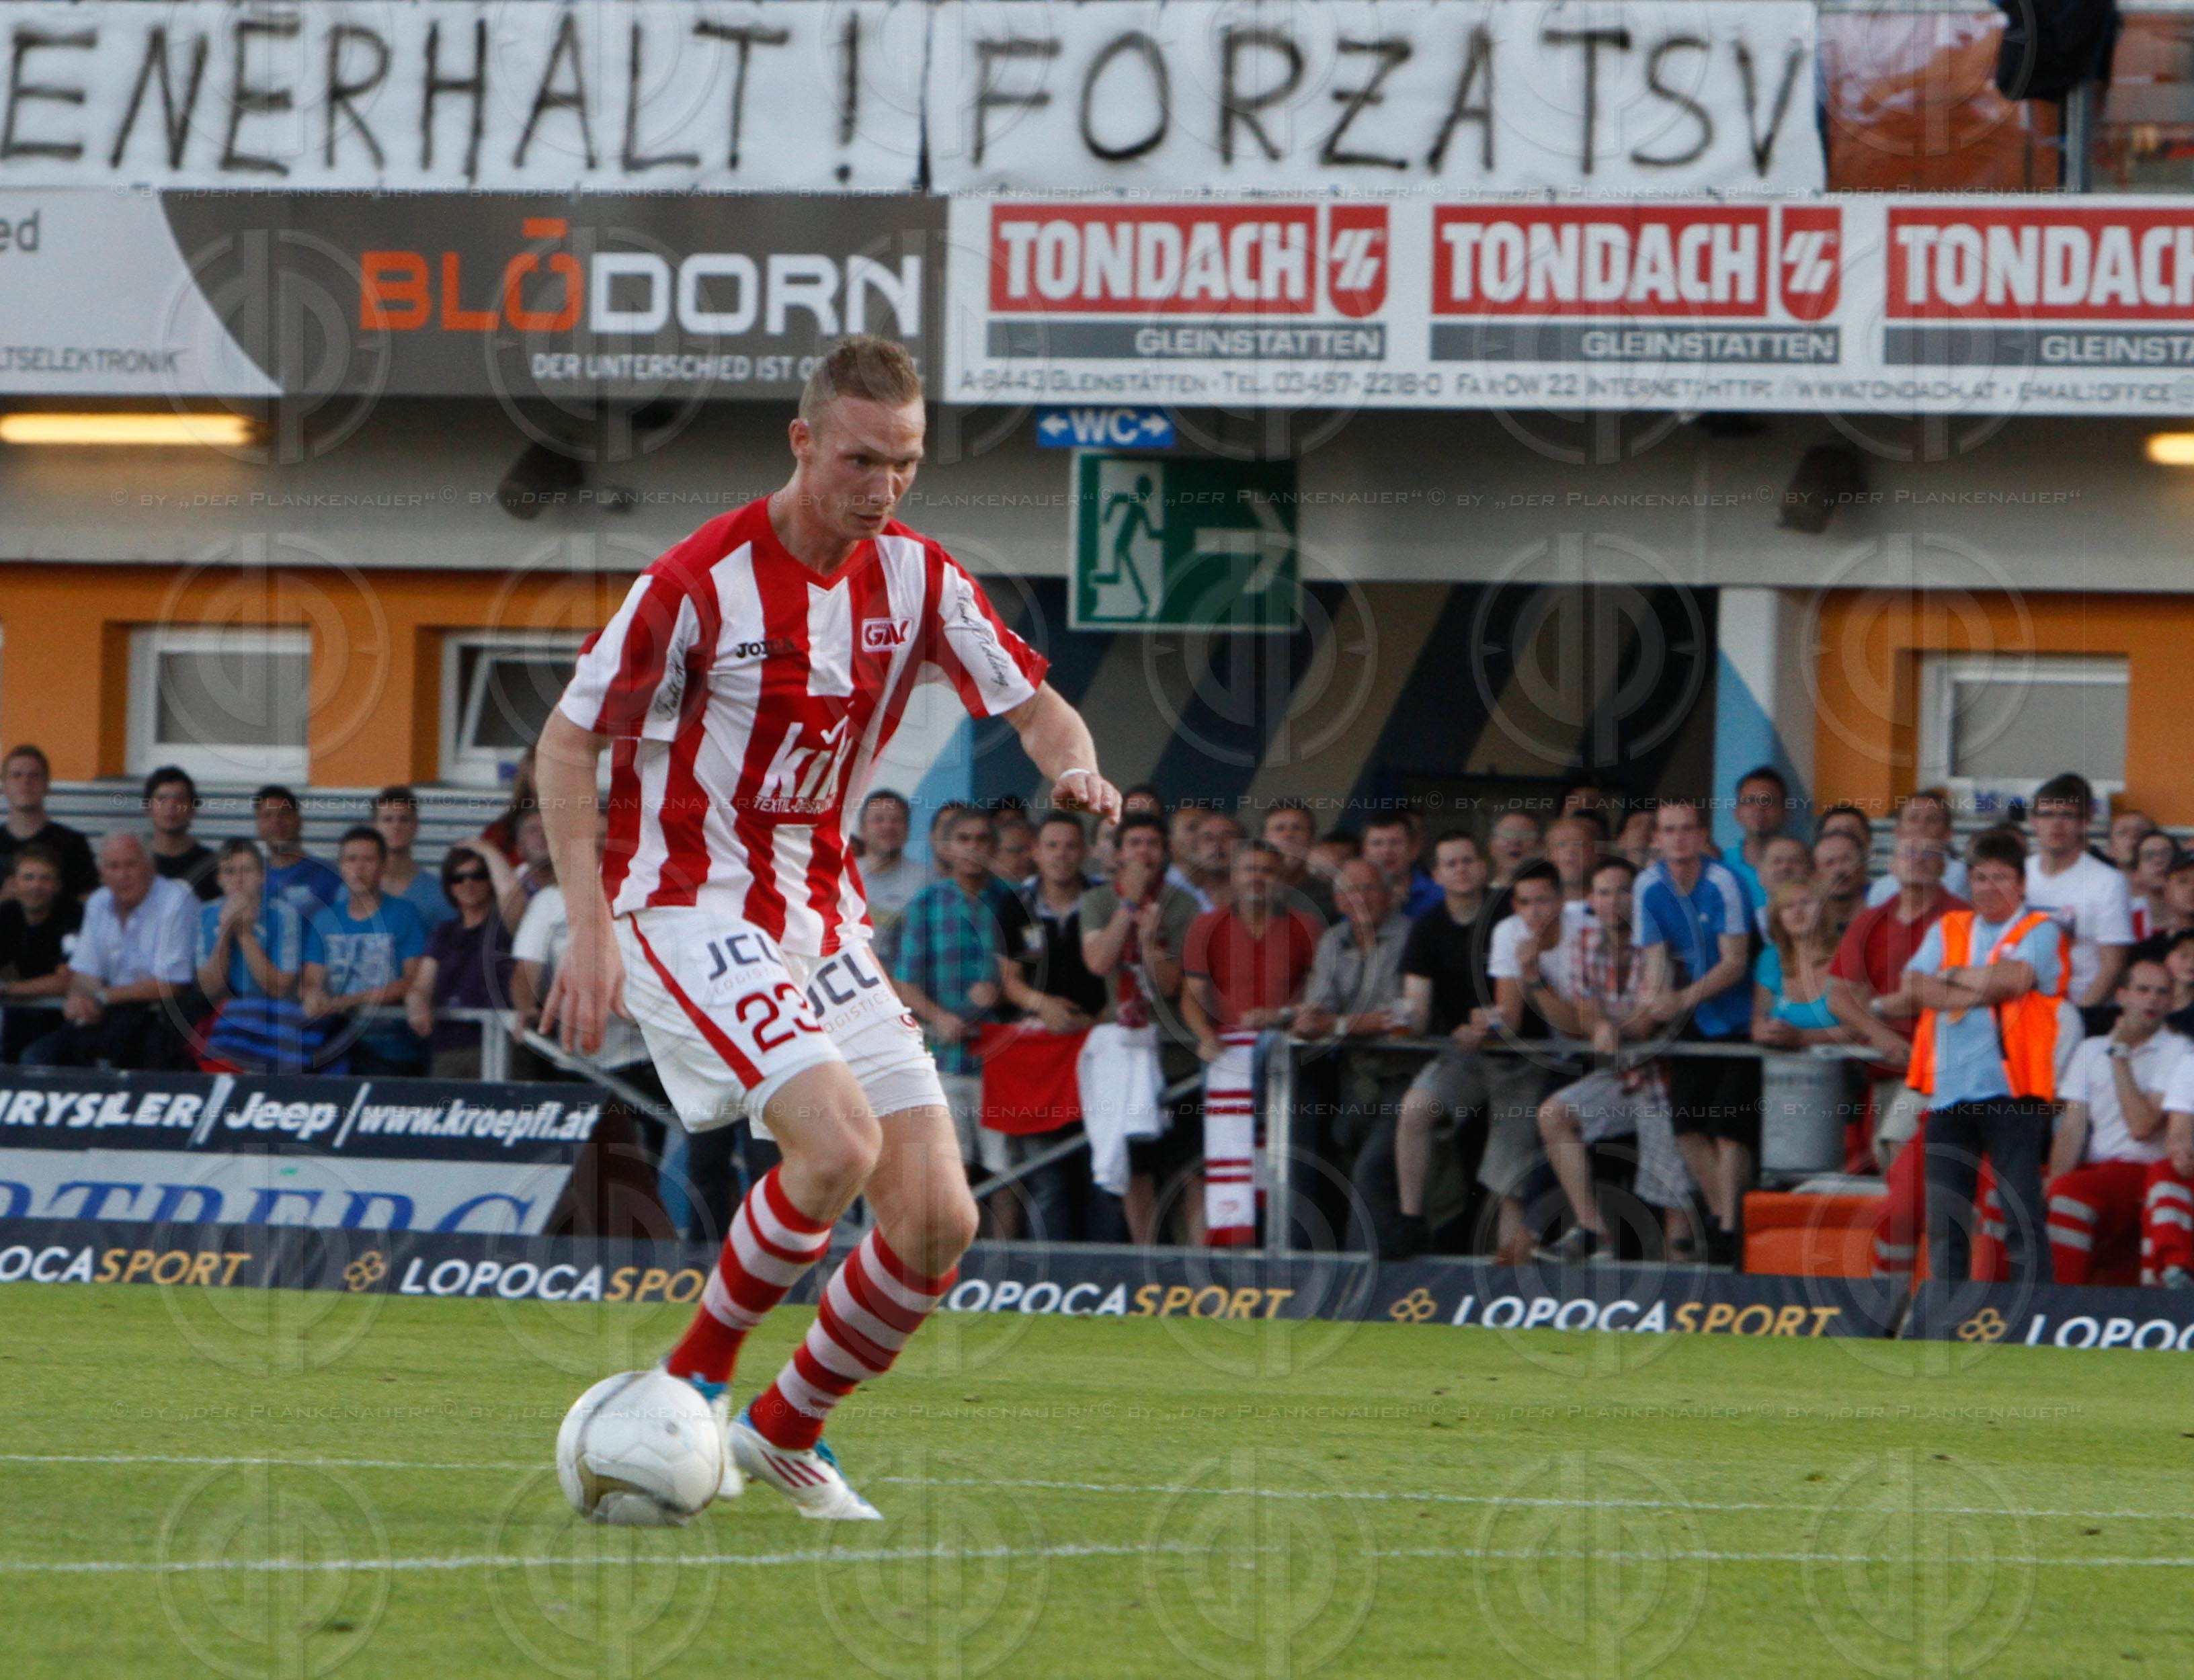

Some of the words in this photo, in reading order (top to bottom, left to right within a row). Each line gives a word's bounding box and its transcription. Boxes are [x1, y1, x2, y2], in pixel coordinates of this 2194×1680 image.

[999, 220, 1308, 302] TONDACH
[1440, 221, 1760, 304] TONDACH
[531, 352, 580, 380] DER
[1069, 408, 1139, 446] WC
[807, 953, 880, 1019] JCL
[823, 989, 891, 1034] OGISTICS
[735, 982, 825, 1054] 23
[224, 1091, 337, 1140] Jeep
[358, 1097, 602, 1148] www.kroepfl.at
